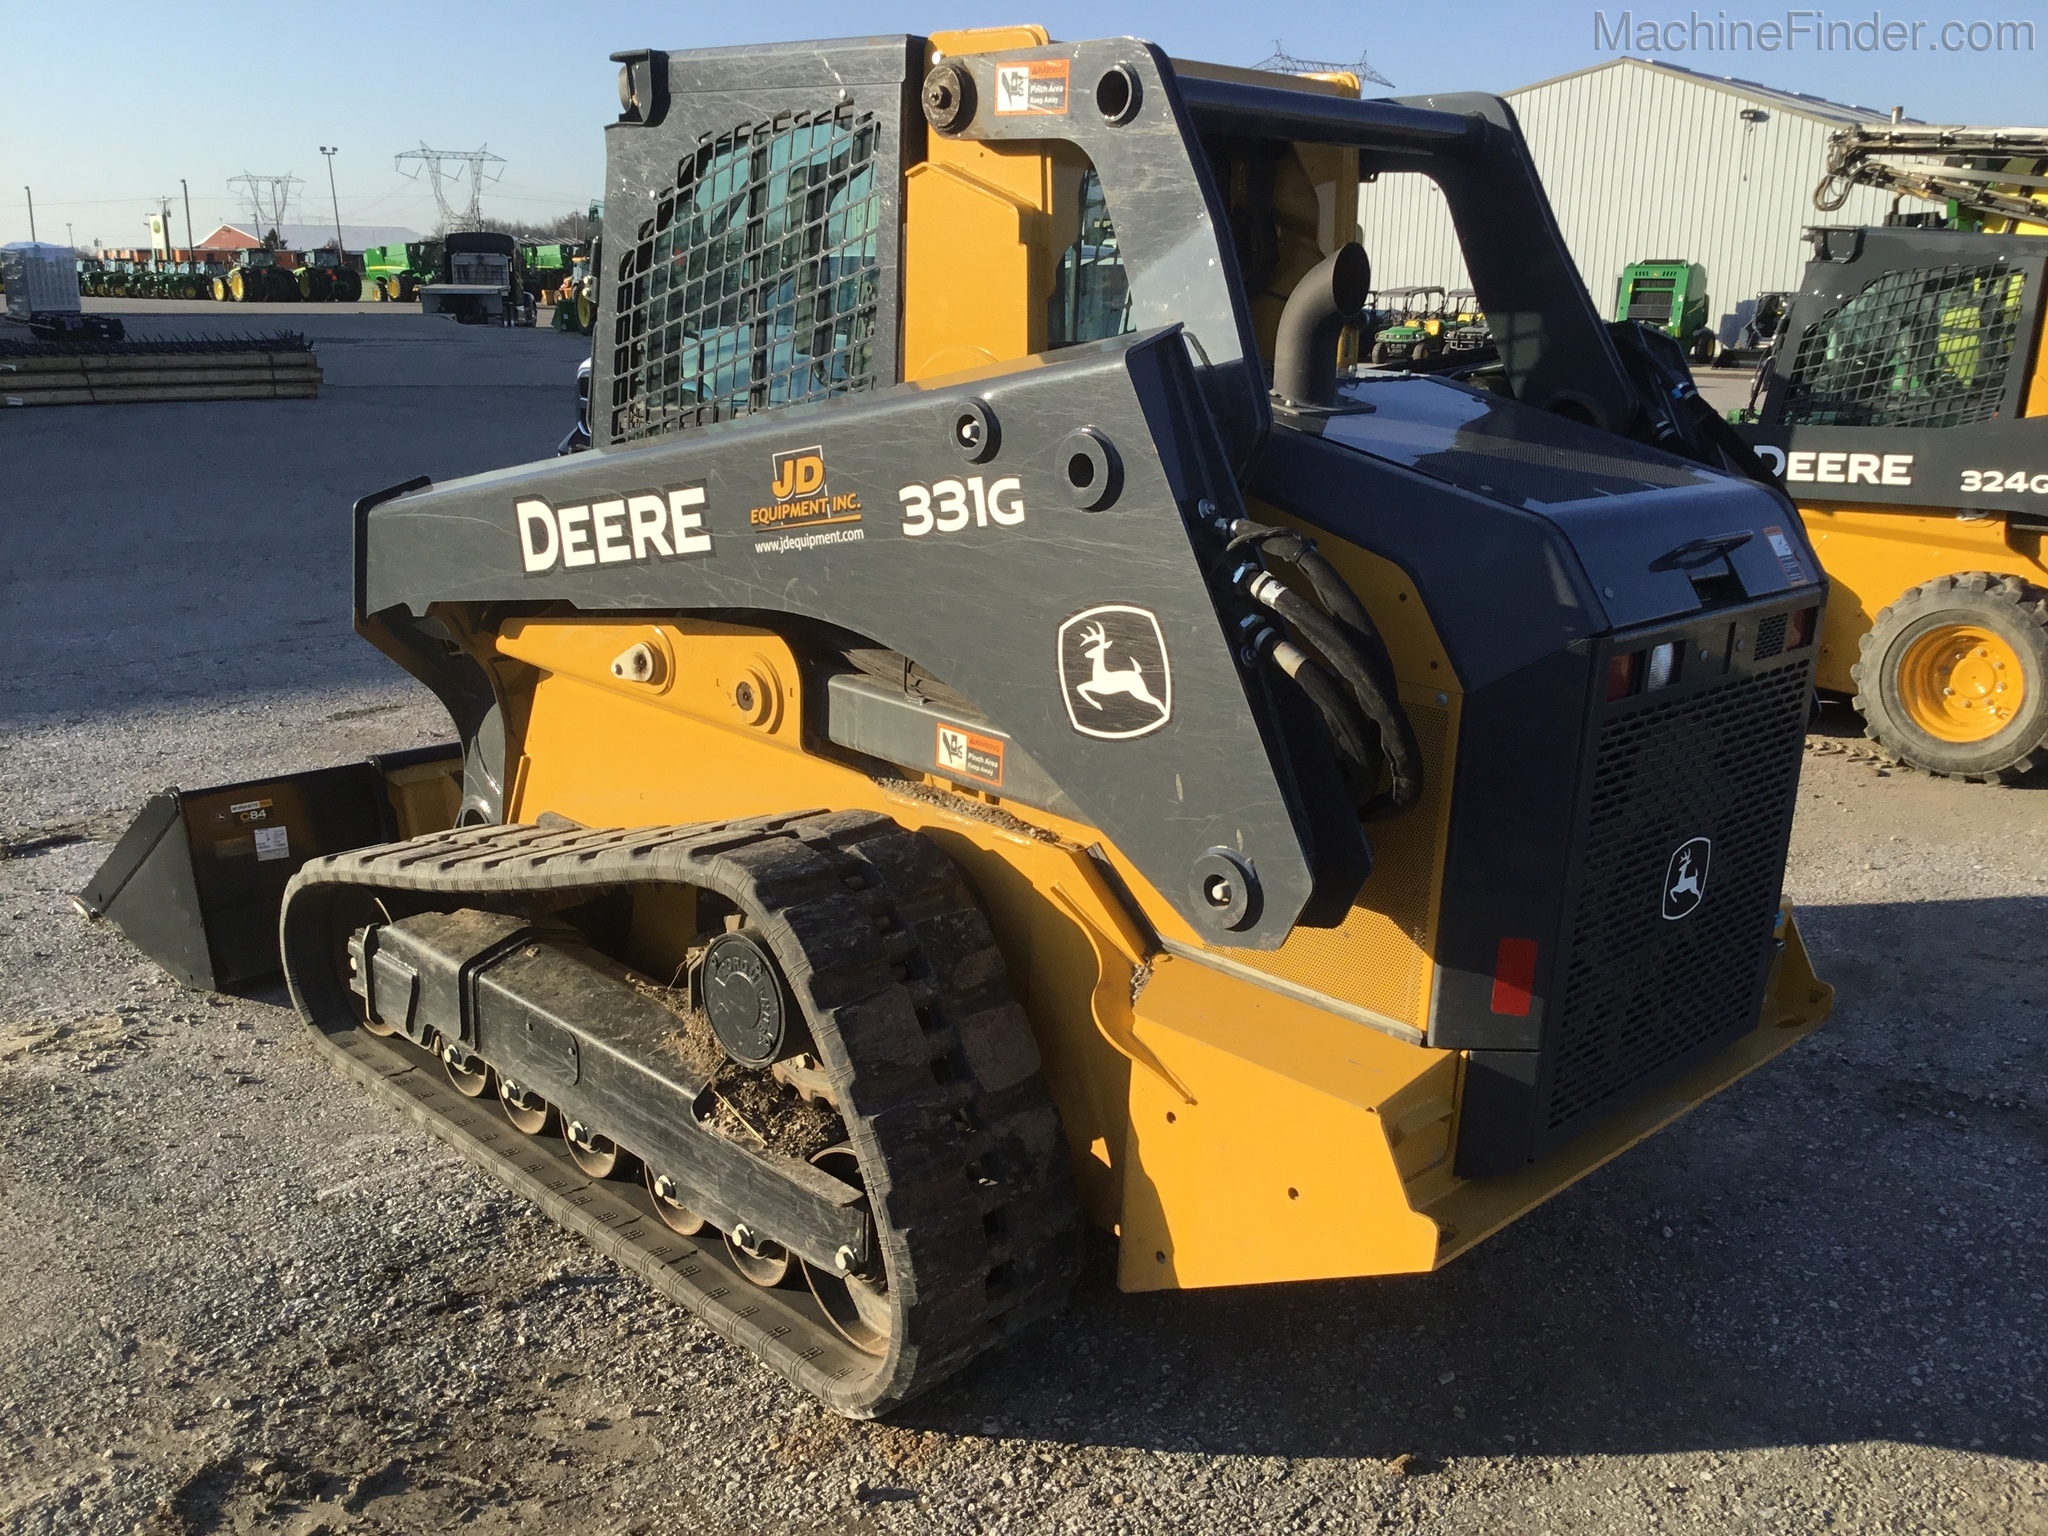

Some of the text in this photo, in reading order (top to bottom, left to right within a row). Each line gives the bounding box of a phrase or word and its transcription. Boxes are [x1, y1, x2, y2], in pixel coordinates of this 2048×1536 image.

[1036, 65, 1066, 75] WARNING
[1030, 83, 1064, 94] Pinch Area
[1029, 96, 1059, 105] Keep Away
[772, 455, 825, 501] JD
[750, 493, 862, 525] EQUIPMENT INC.
[898, 476, 1025, 536] 331G
[516, 487, 712, 572] DEERE
[754, 528, 865, 554] www.jdequipment.com
[967, 752, 998, 768] Pinch Area
[967, 762, 994, 777] Keep Away
